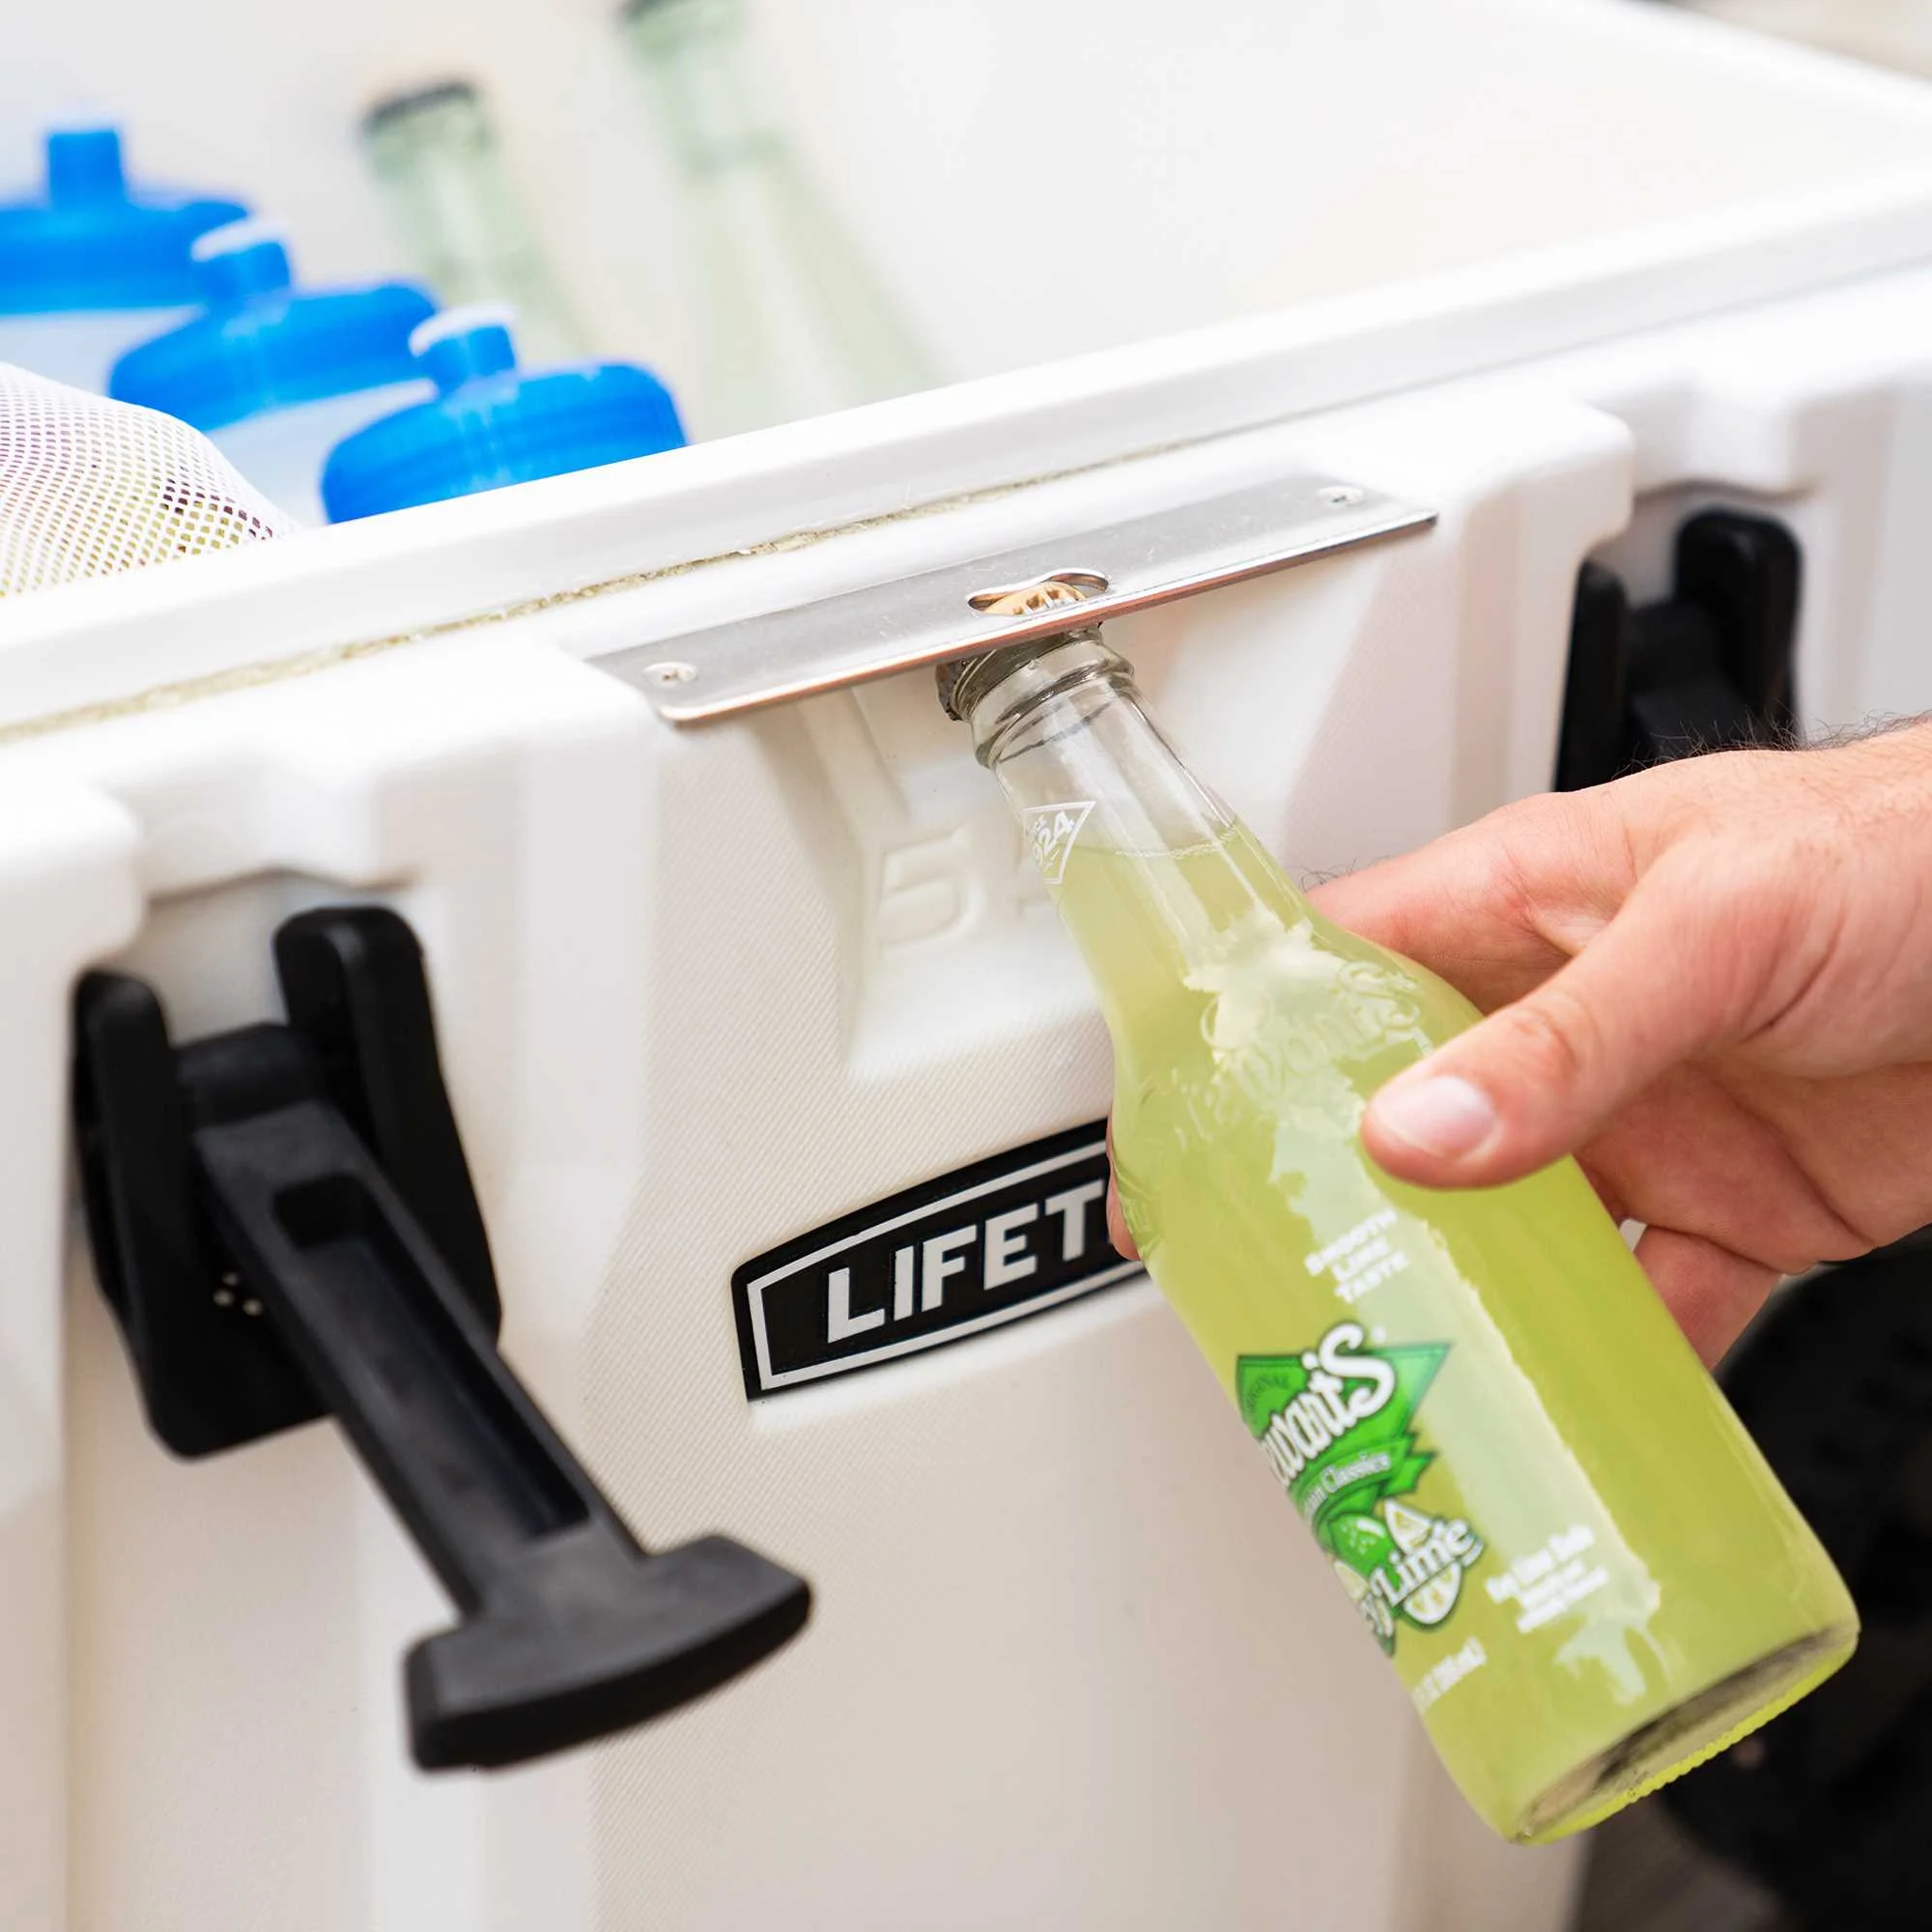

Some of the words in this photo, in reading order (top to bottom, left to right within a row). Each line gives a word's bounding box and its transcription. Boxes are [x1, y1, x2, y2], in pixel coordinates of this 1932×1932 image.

[1031, 810, 1075, 868] 924
[827, 1179, 1106, 1344] LIFET
[1369, 1517, 1482, 1607] Lime
